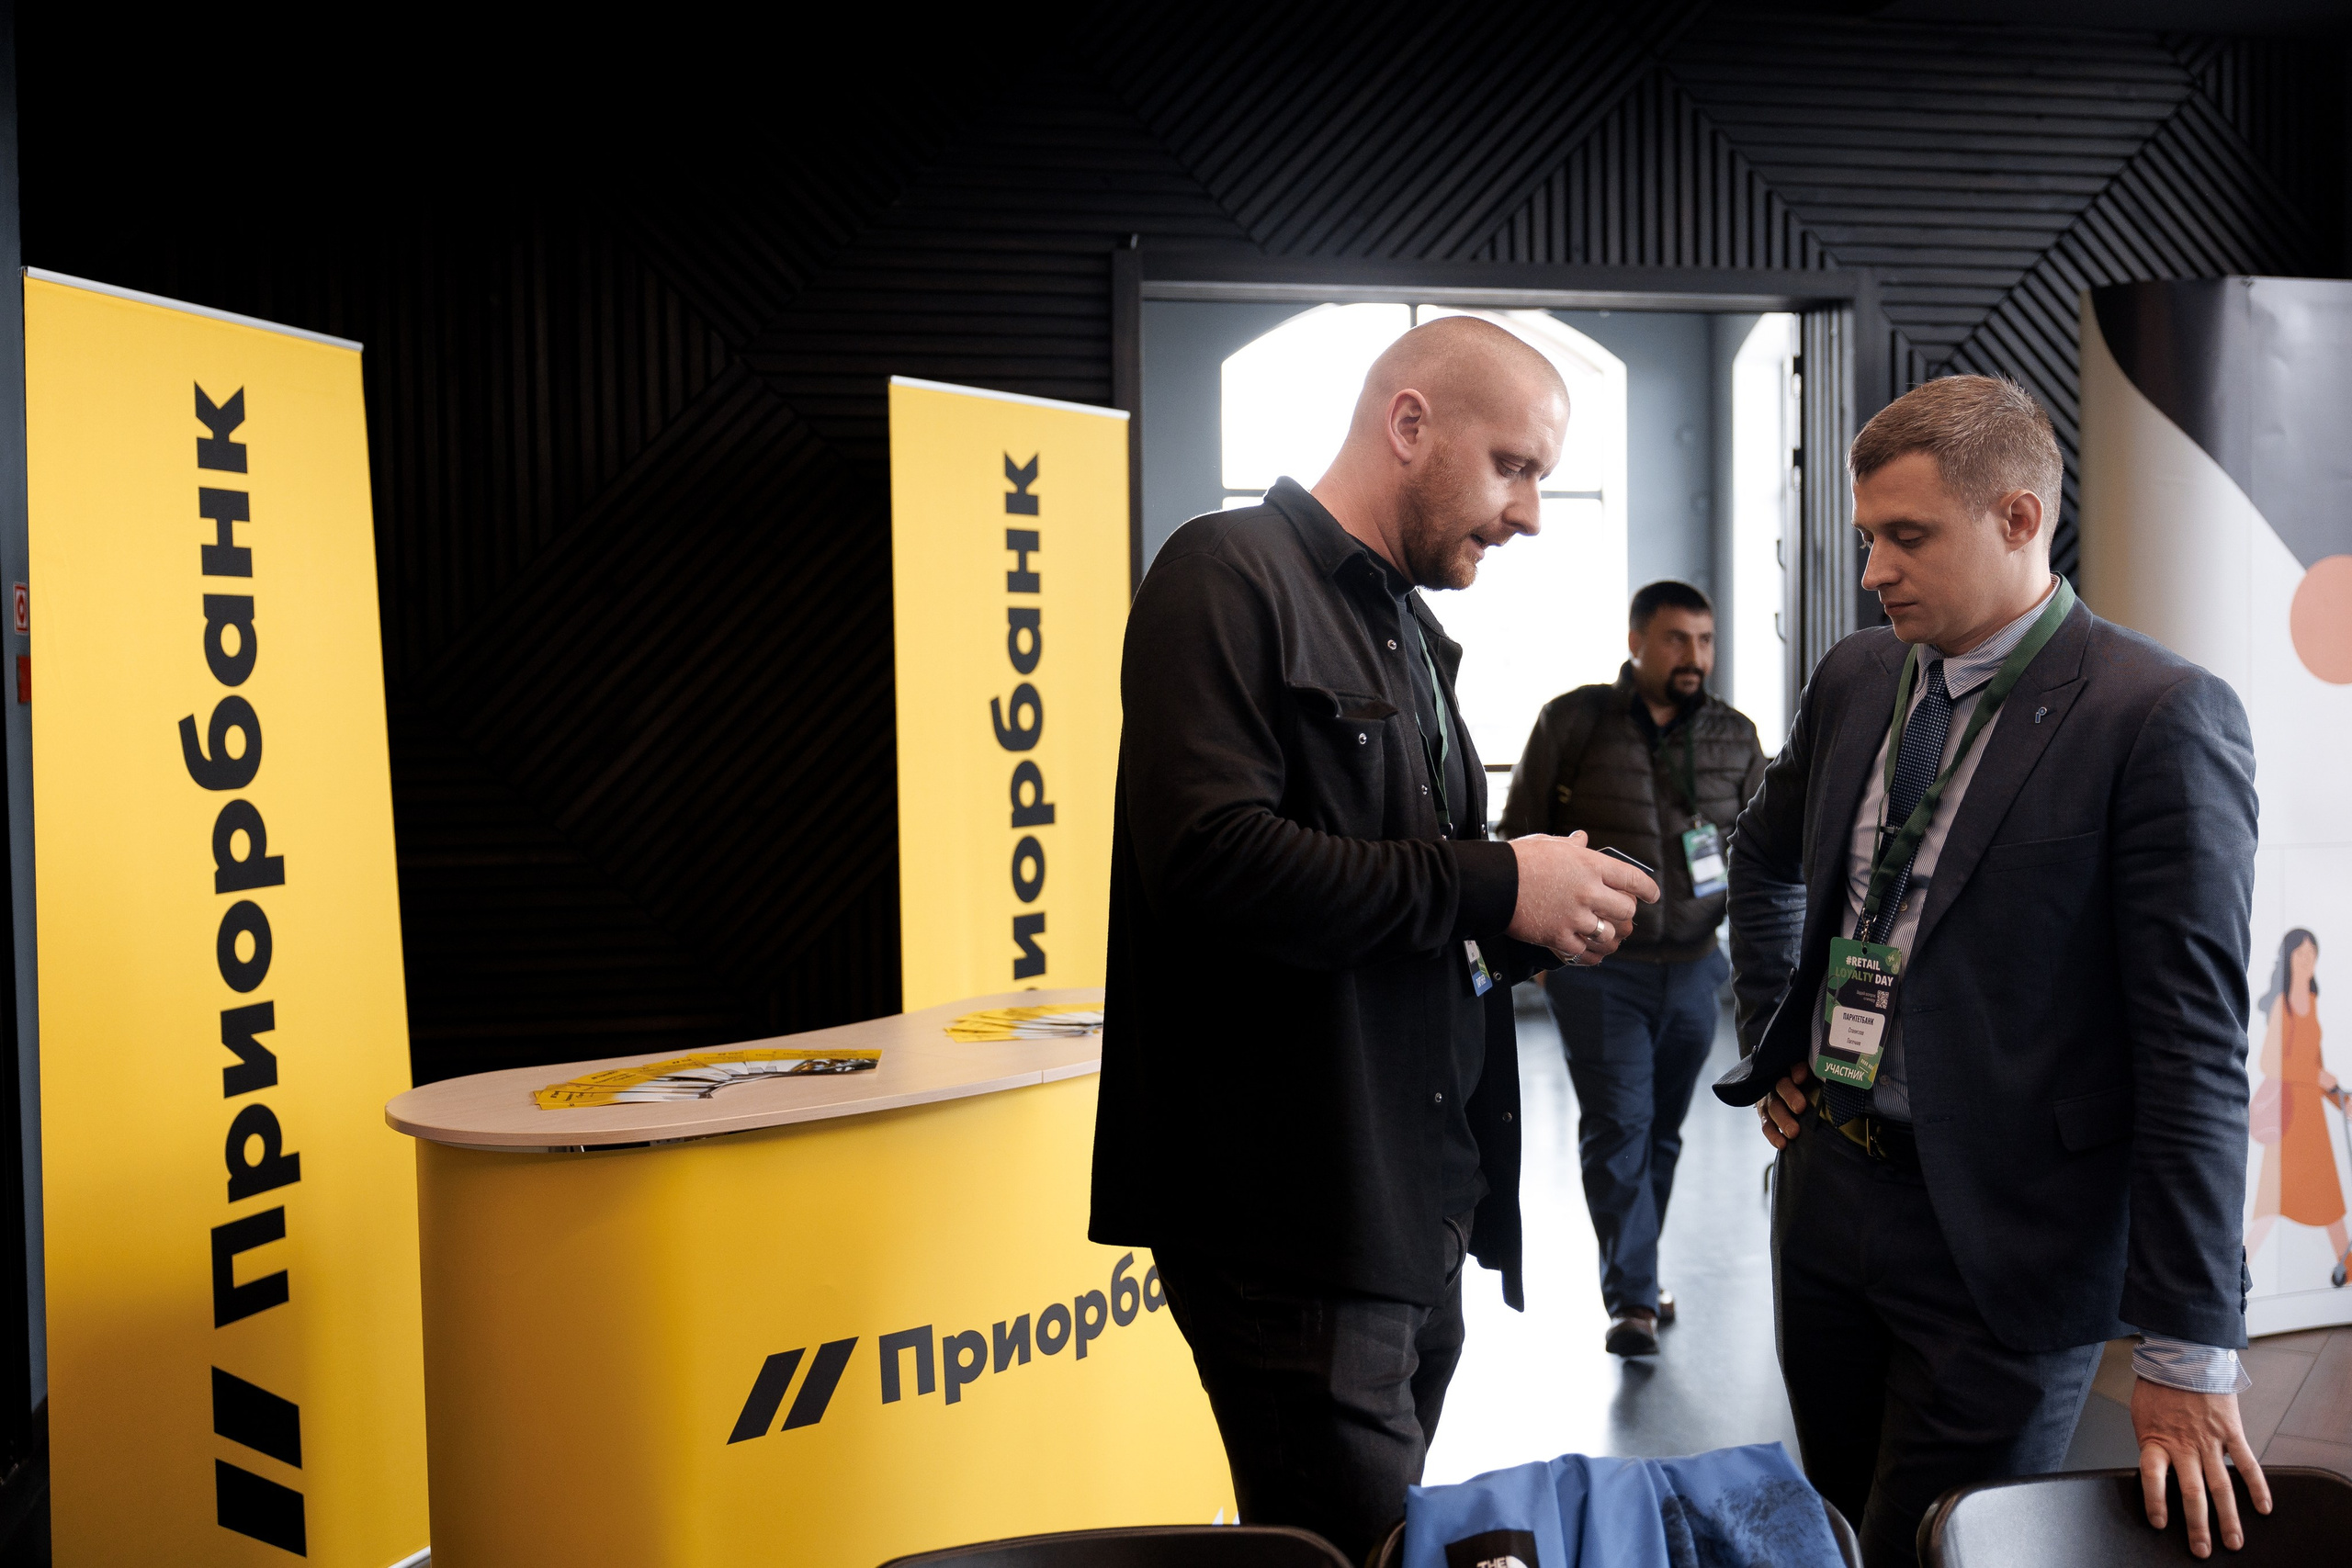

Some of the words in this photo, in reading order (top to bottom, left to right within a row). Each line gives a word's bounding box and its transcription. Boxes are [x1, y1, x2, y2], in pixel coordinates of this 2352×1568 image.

[990, 449, 1057, 990] иорбанк
[178, 378, 301, 1330] Приорбанк
[1846, 955, 1881, 971] #RETAIL
[1835, 966, 1874, 983] LOYALTY
[1874, 974, 1894, 987] DAY
[1842, 1012, 1875, 1026] ПАРИТЕТБАНК
[1824, 1062, 1865, 1082] УЧАСТНИК
